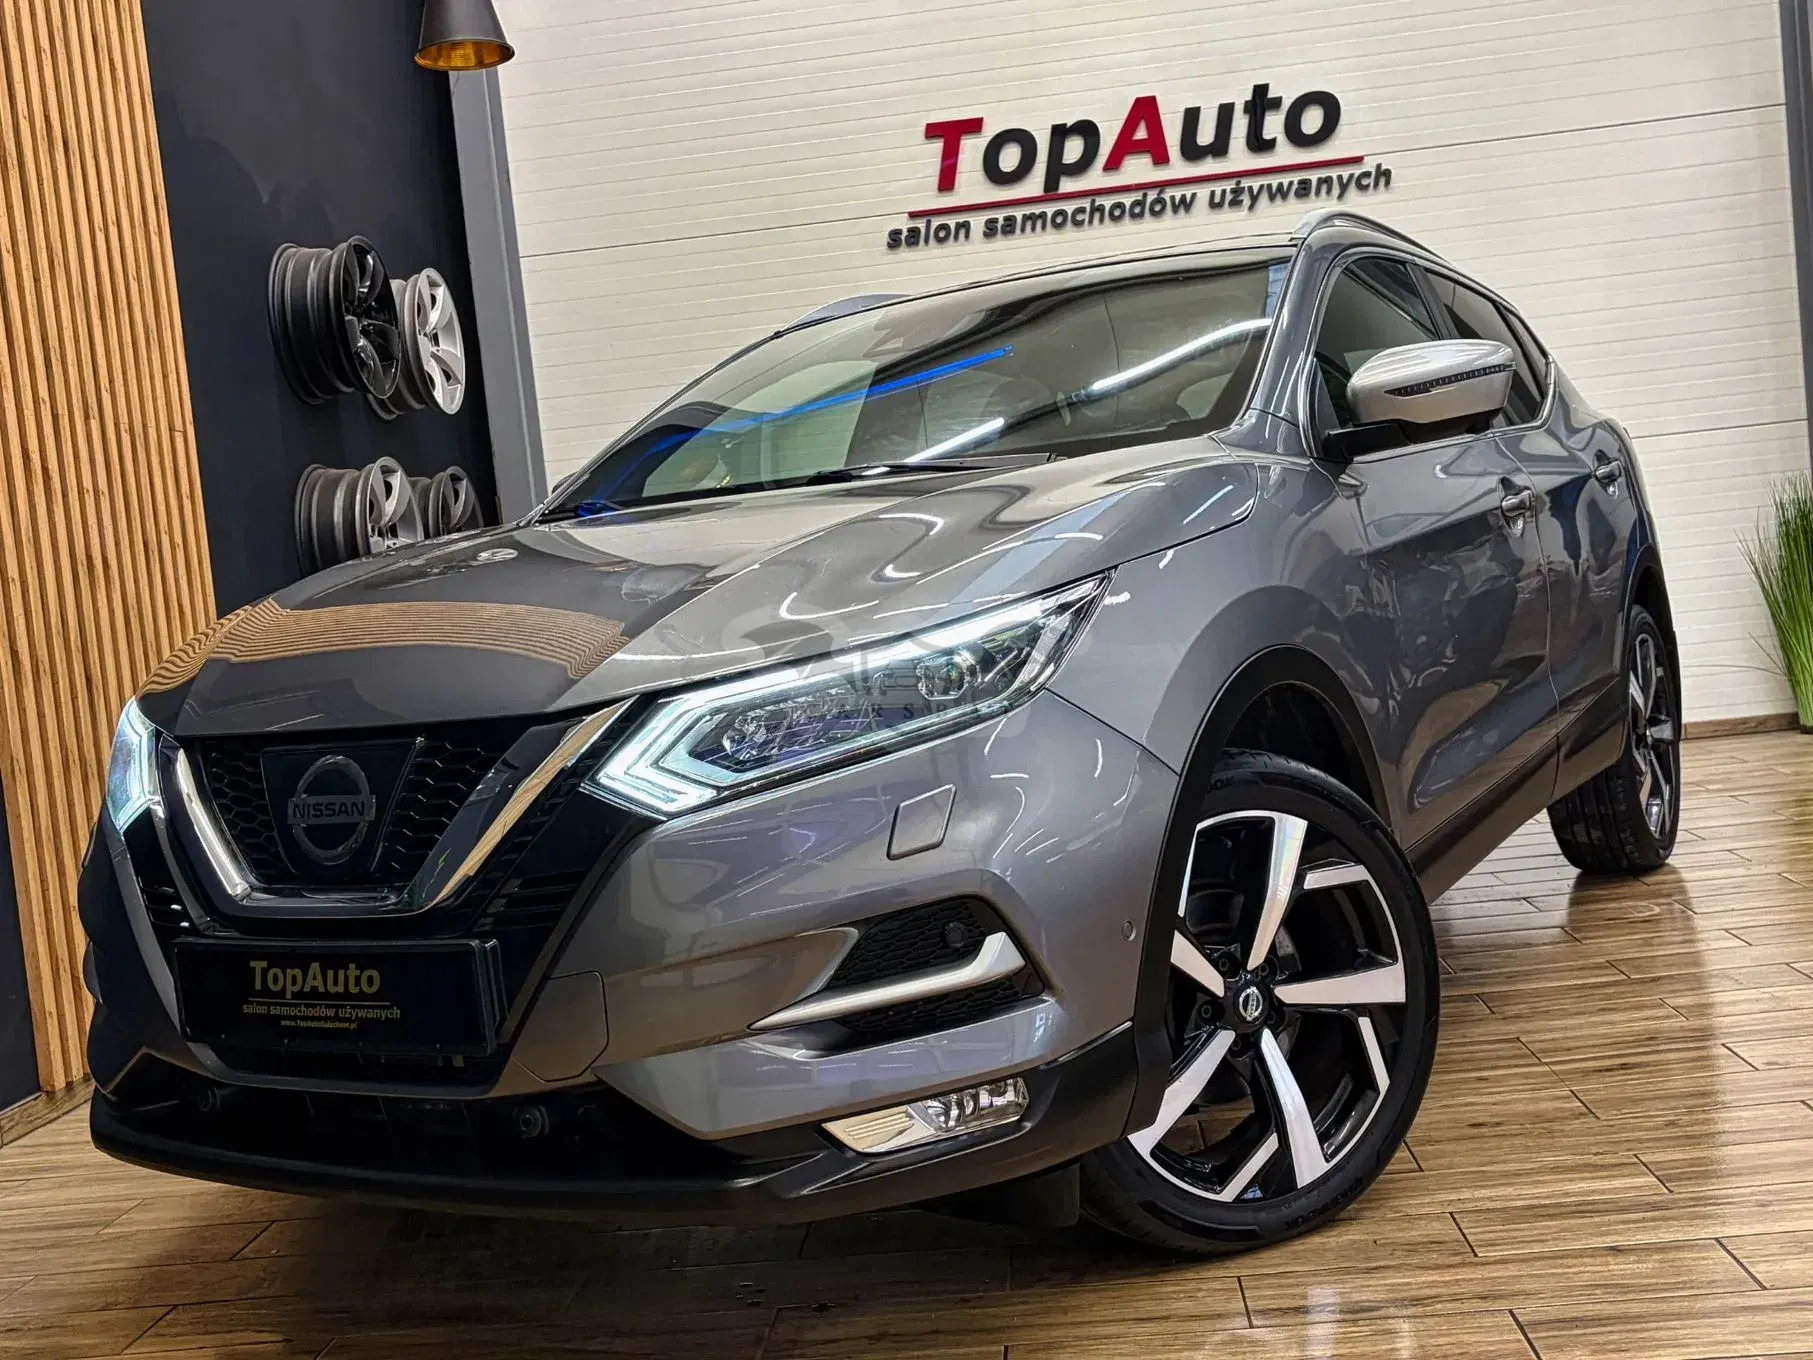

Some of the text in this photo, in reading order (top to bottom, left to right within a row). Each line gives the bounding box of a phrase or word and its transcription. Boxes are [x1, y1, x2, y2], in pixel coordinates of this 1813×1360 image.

[924, 83, 1342, 193] TopAuto
[887, 163, 1392, 249] salon samochodów używanych
[292, 801, 365, 819] NISSAN
[249, 960, 381, 999] TopAuto
[242, 1003, 401, 1021] salon samochodów używanych
